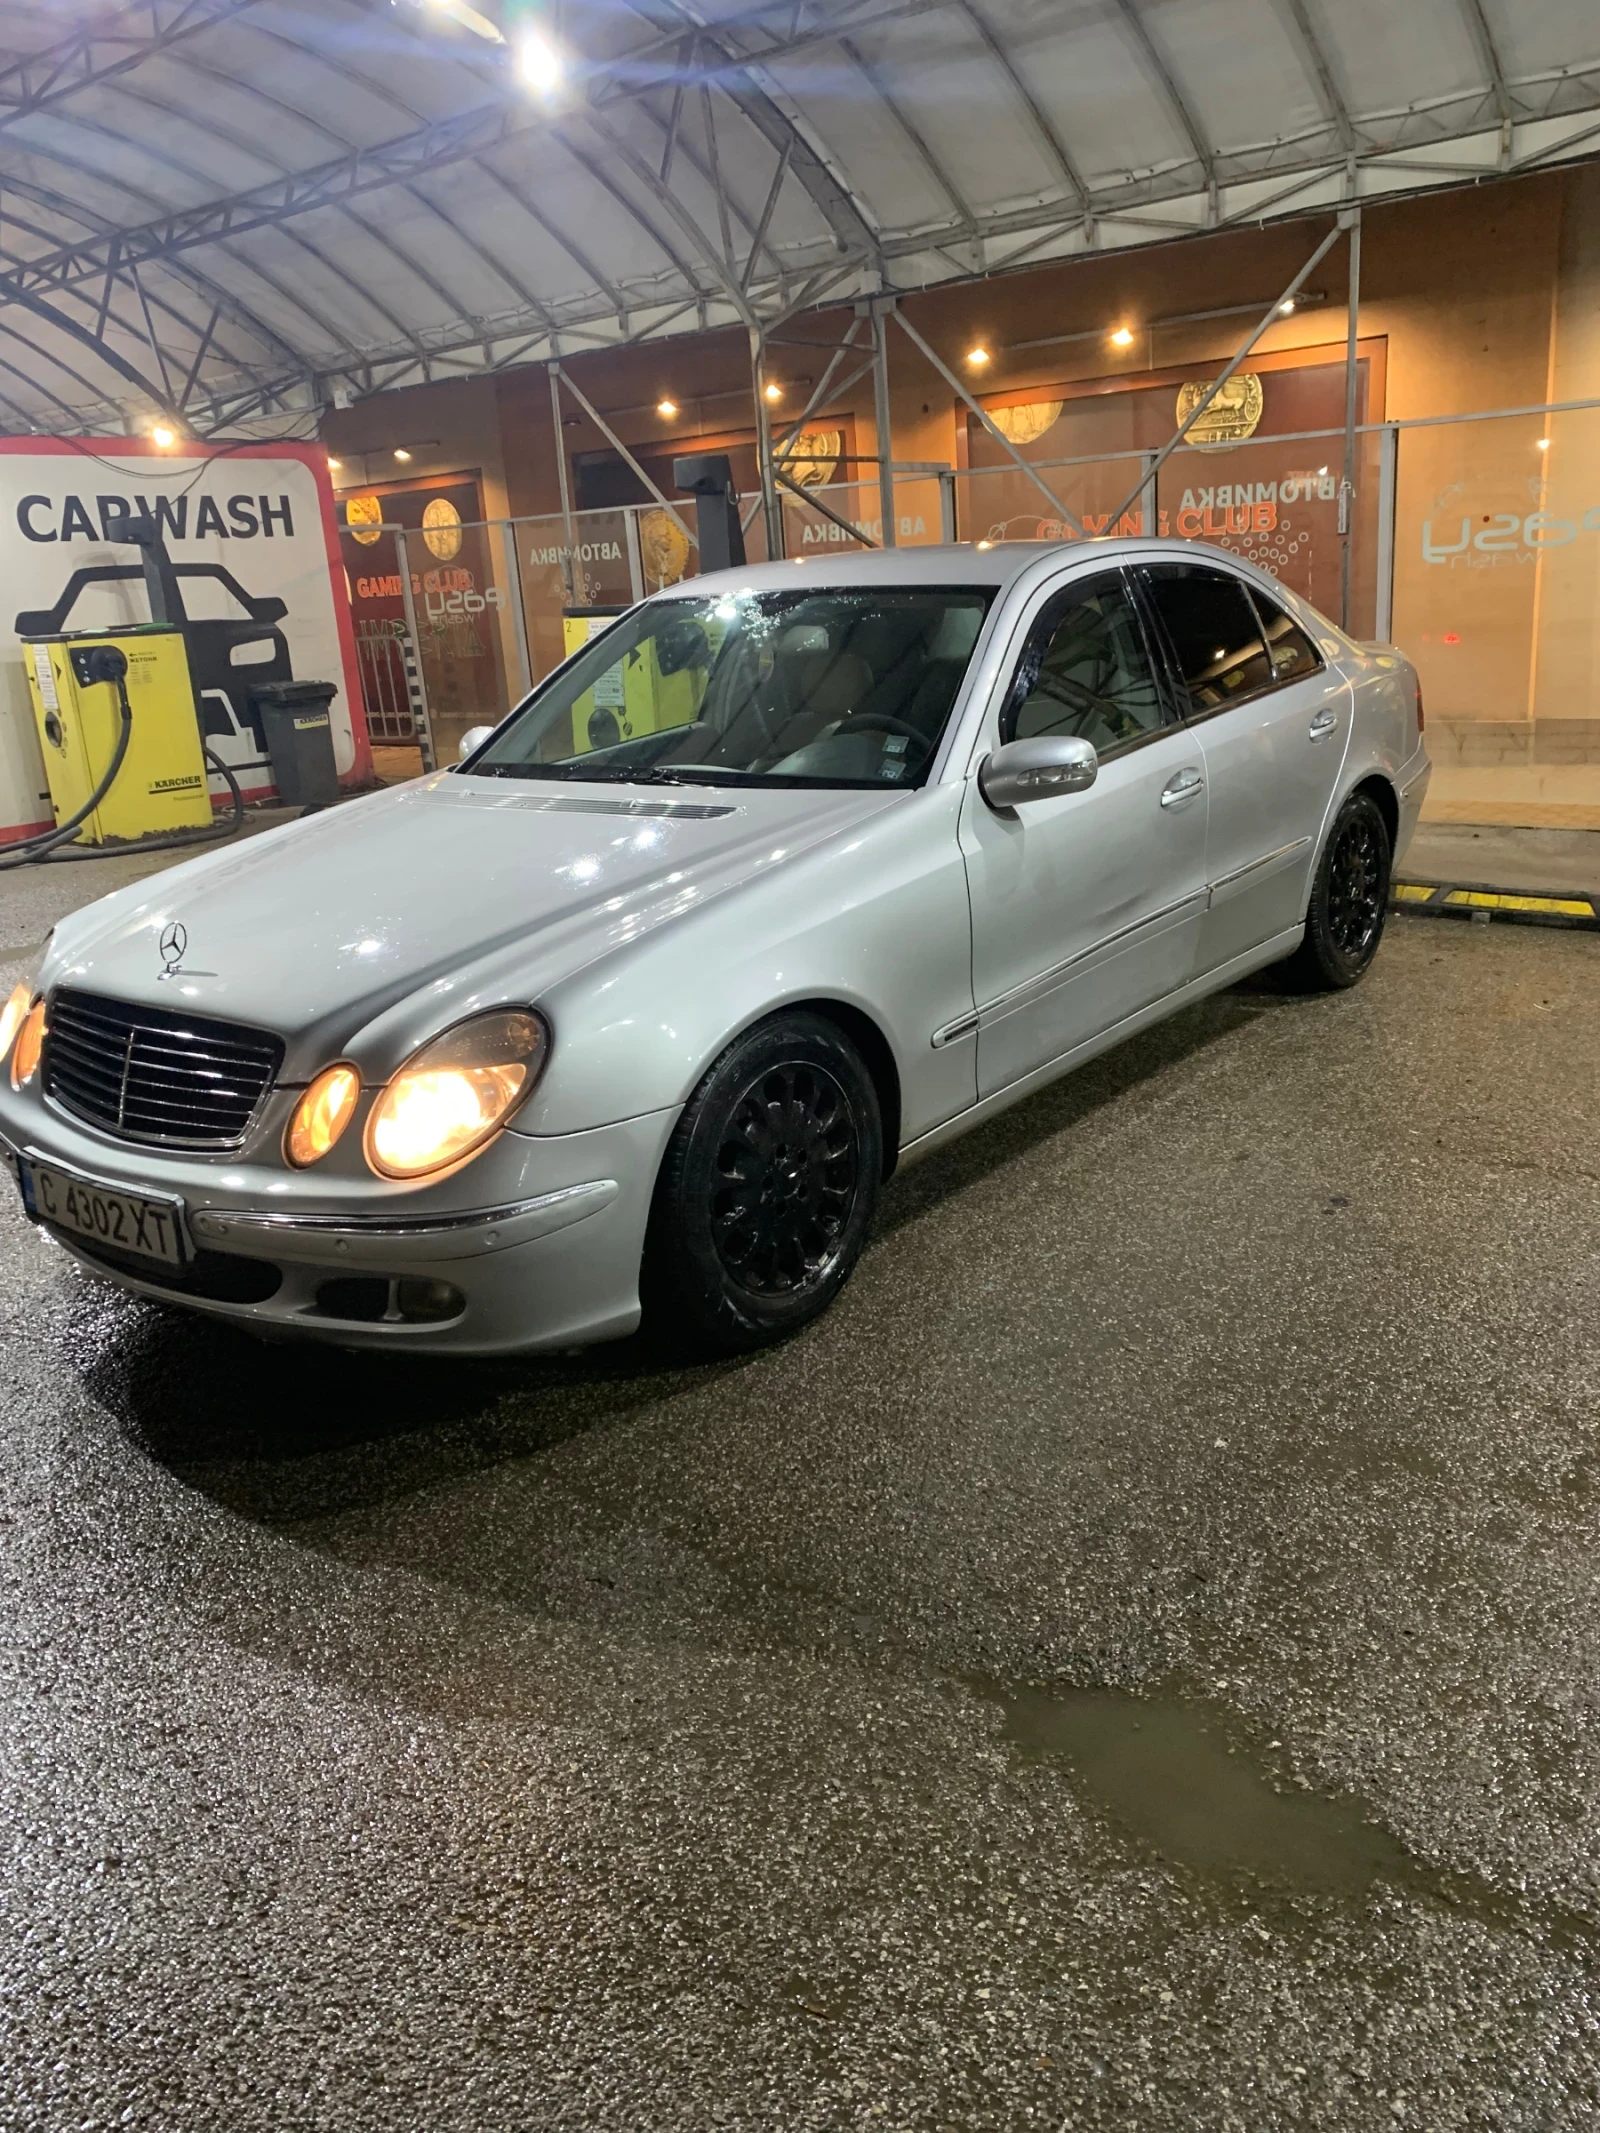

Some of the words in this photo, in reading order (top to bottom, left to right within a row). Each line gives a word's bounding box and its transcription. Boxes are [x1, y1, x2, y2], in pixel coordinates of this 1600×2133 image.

[1177, 502, 1278, 537] CLUB
[356, 573, 421, 598] GAMIG
[423, 568, 471, 593] CLUB
[566, 621, 572, 632] 2
[40, 1173, 57, 1215] C
